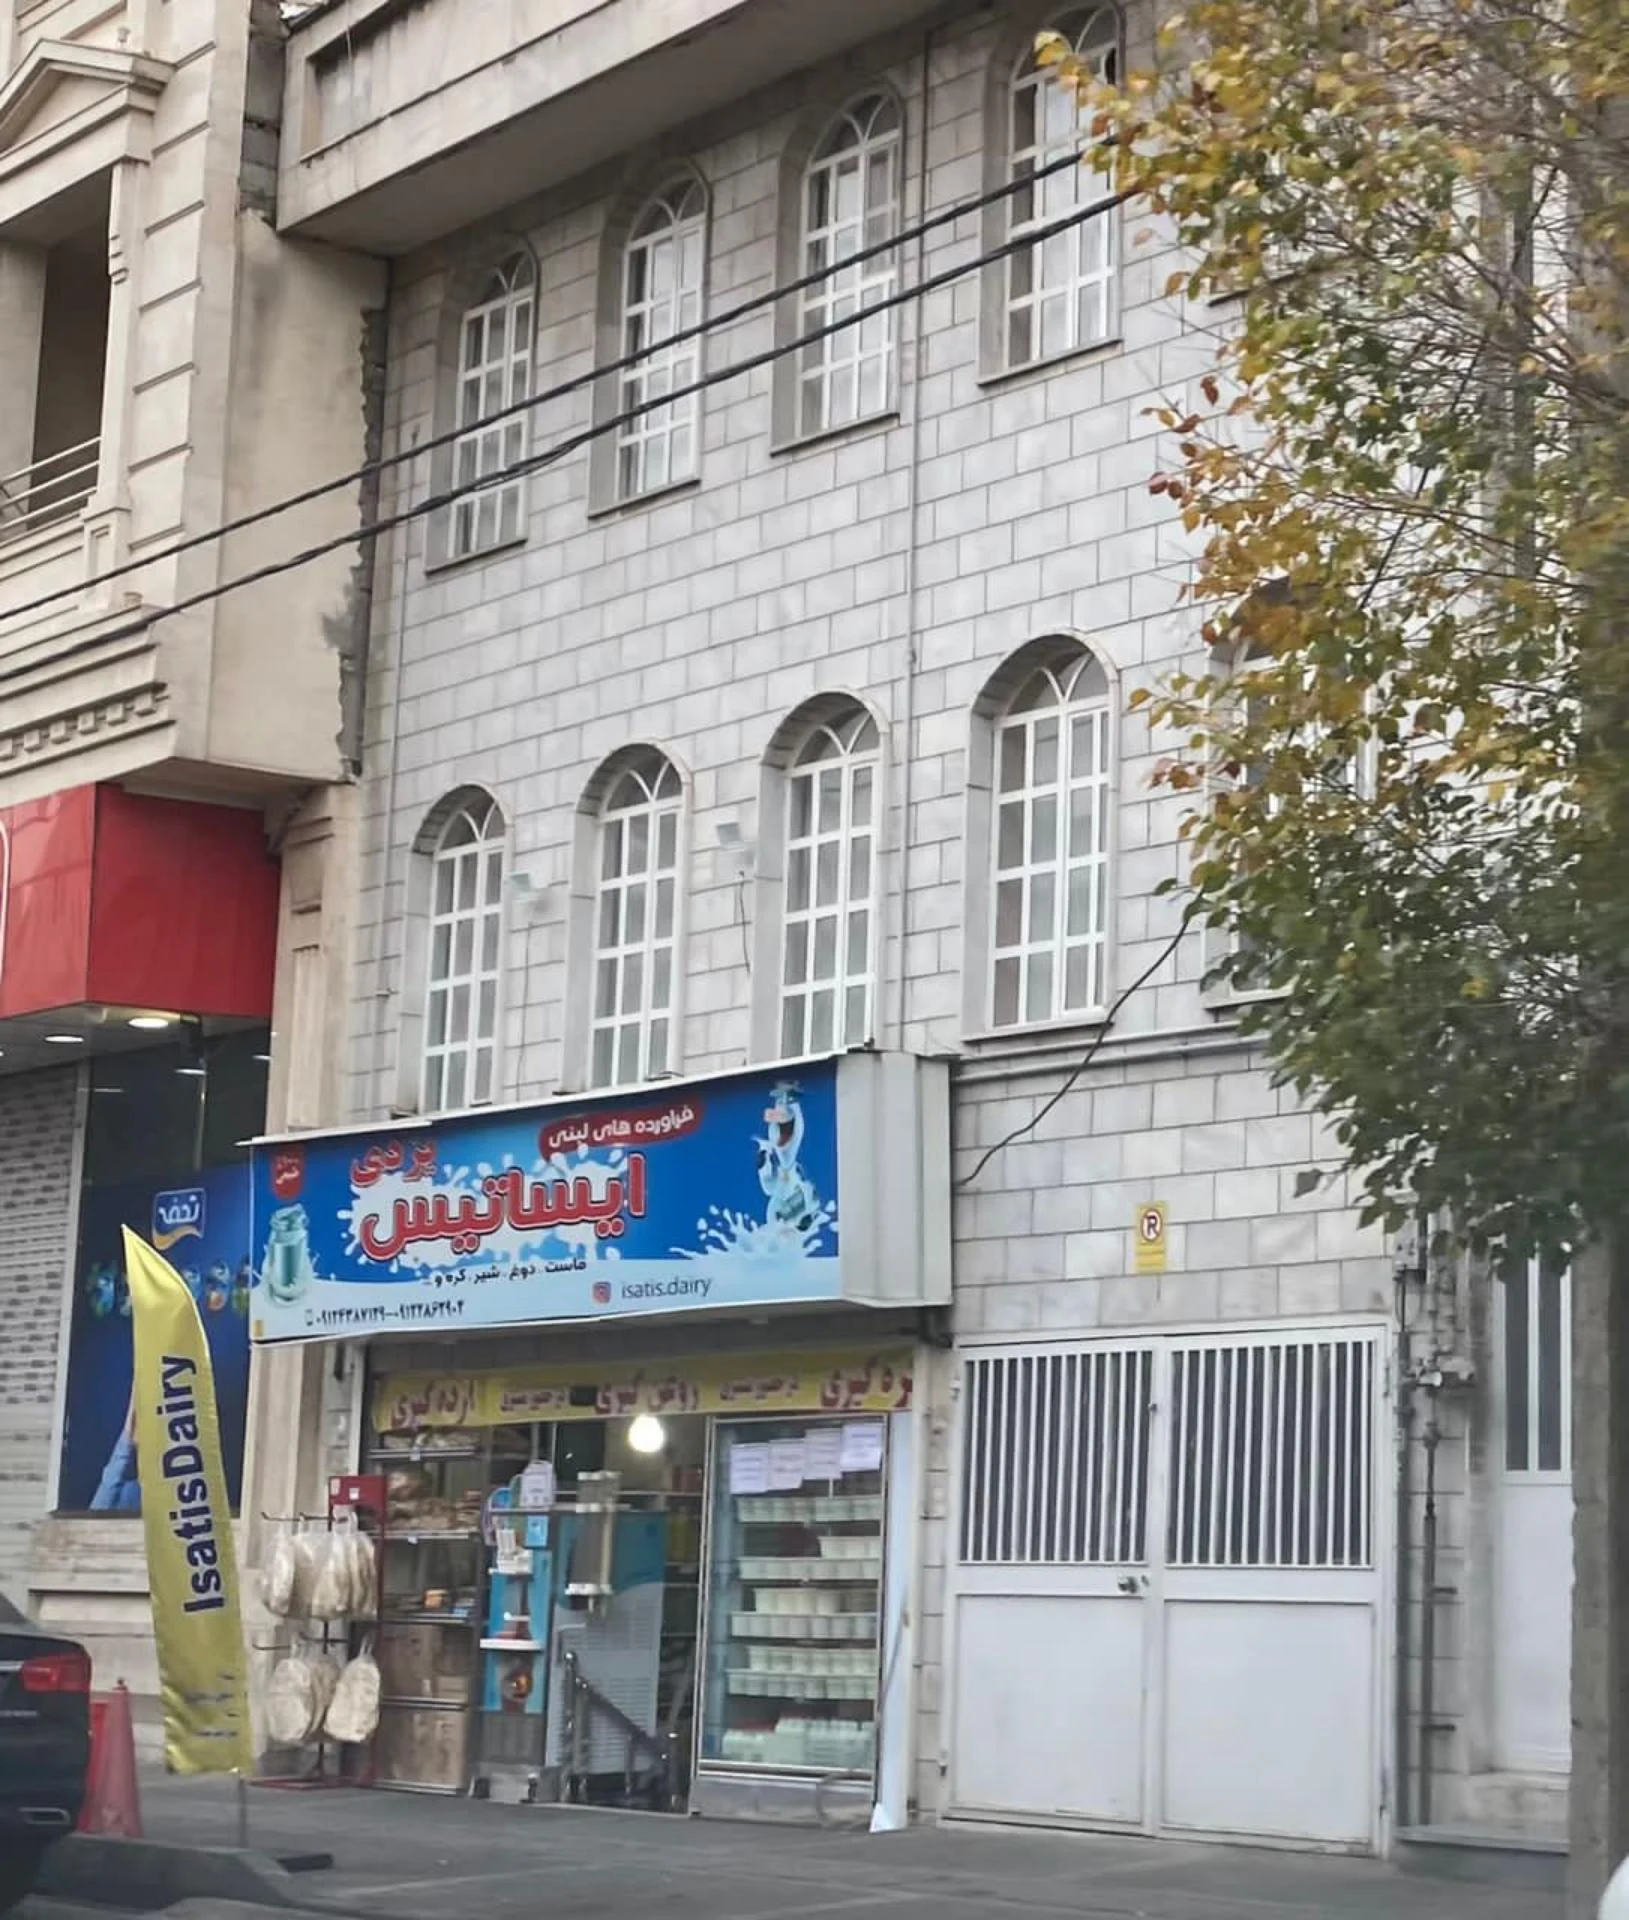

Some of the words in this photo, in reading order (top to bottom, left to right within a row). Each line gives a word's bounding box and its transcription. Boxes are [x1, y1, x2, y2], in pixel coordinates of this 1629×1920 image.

[548, 1122, 589, 1148] لبنی
[592, 1119, 632, 1141] های
[360, 1151, 646, 1262] ایساتیس
[474, 1265, 500, 1284] شیر
[509, 1263, 536, 1281] دوغ
[544, 1256, 587, 1273] ماست
[445, 1268, 467, 1286] کره
[621, 1274, 713, 1297] isatis.dairy
